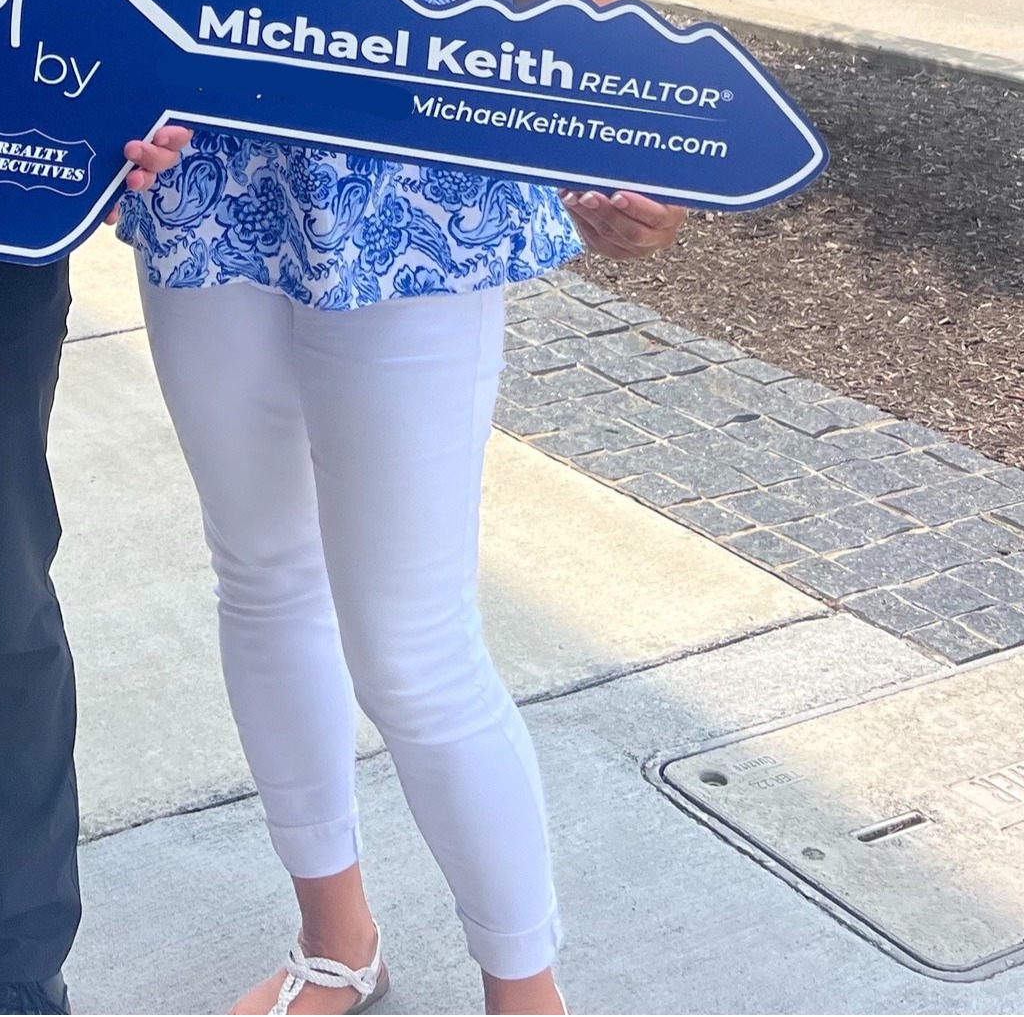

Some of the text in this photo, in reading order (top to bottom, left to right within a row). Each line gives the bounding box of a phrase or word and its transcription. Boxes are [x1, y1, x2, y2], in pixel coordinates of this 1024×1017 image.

[34, 42, 101, 97] by
[198, 5, 410, 67] Michael
[427, 36, 573, 89] Keith
[412, 95, 728, 158] MichaelKeithTeam.com
